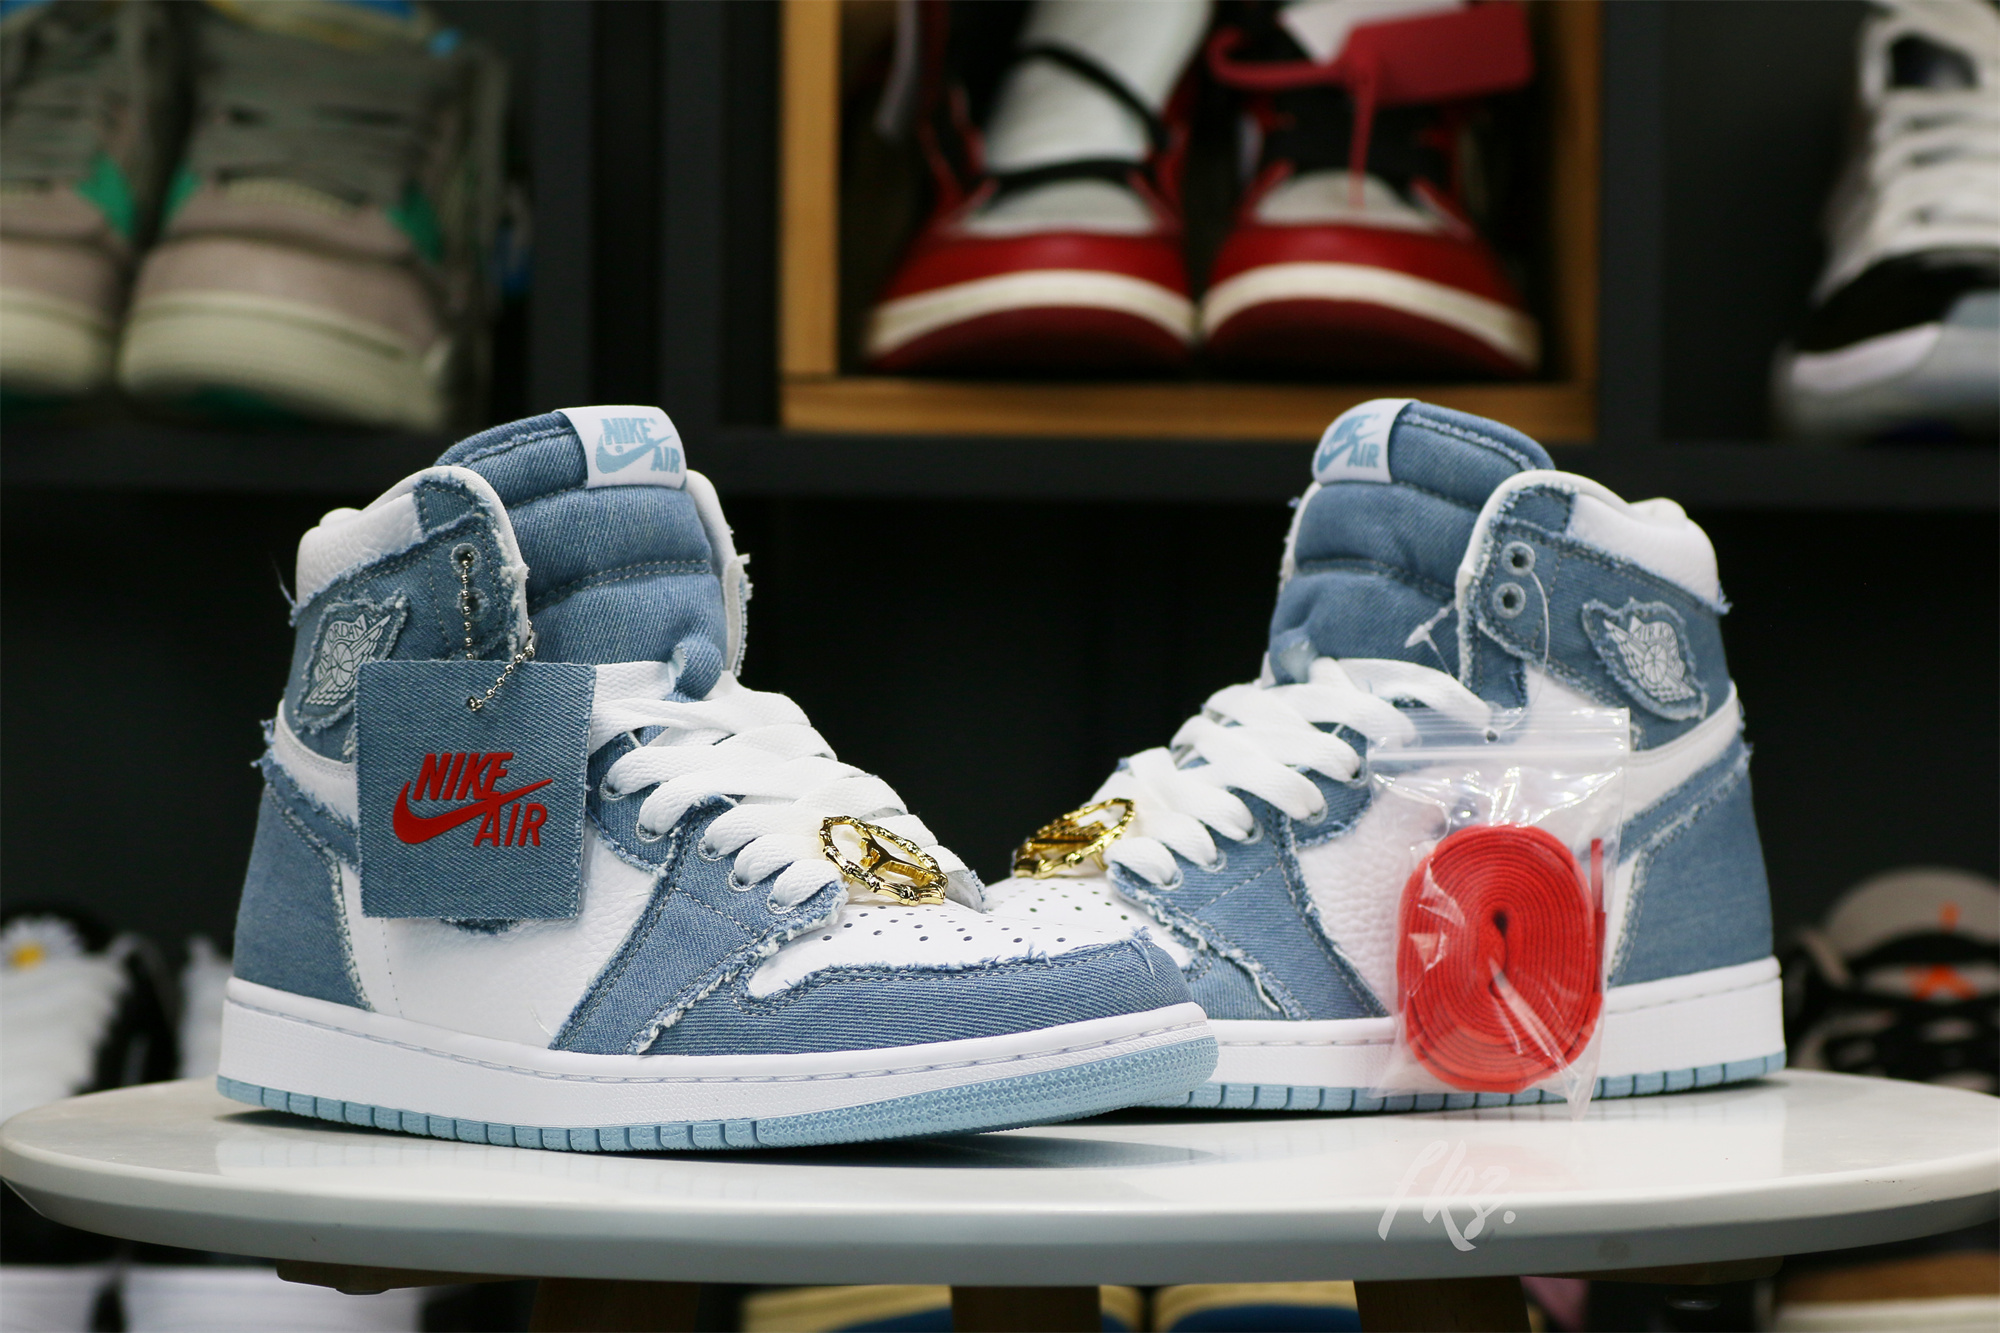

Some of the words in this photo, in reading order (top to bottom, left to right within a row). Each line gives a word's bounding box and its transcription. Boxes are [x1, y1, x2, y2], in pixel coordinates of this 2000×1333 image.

[601, 418, 652, 445] NIKE
[650, 446, 680, 473] AIR
[1346, 443, 1380, 467] AIR
[413, 752, 513, 800] NIKE
[473, 803, 547, 847] AIR
